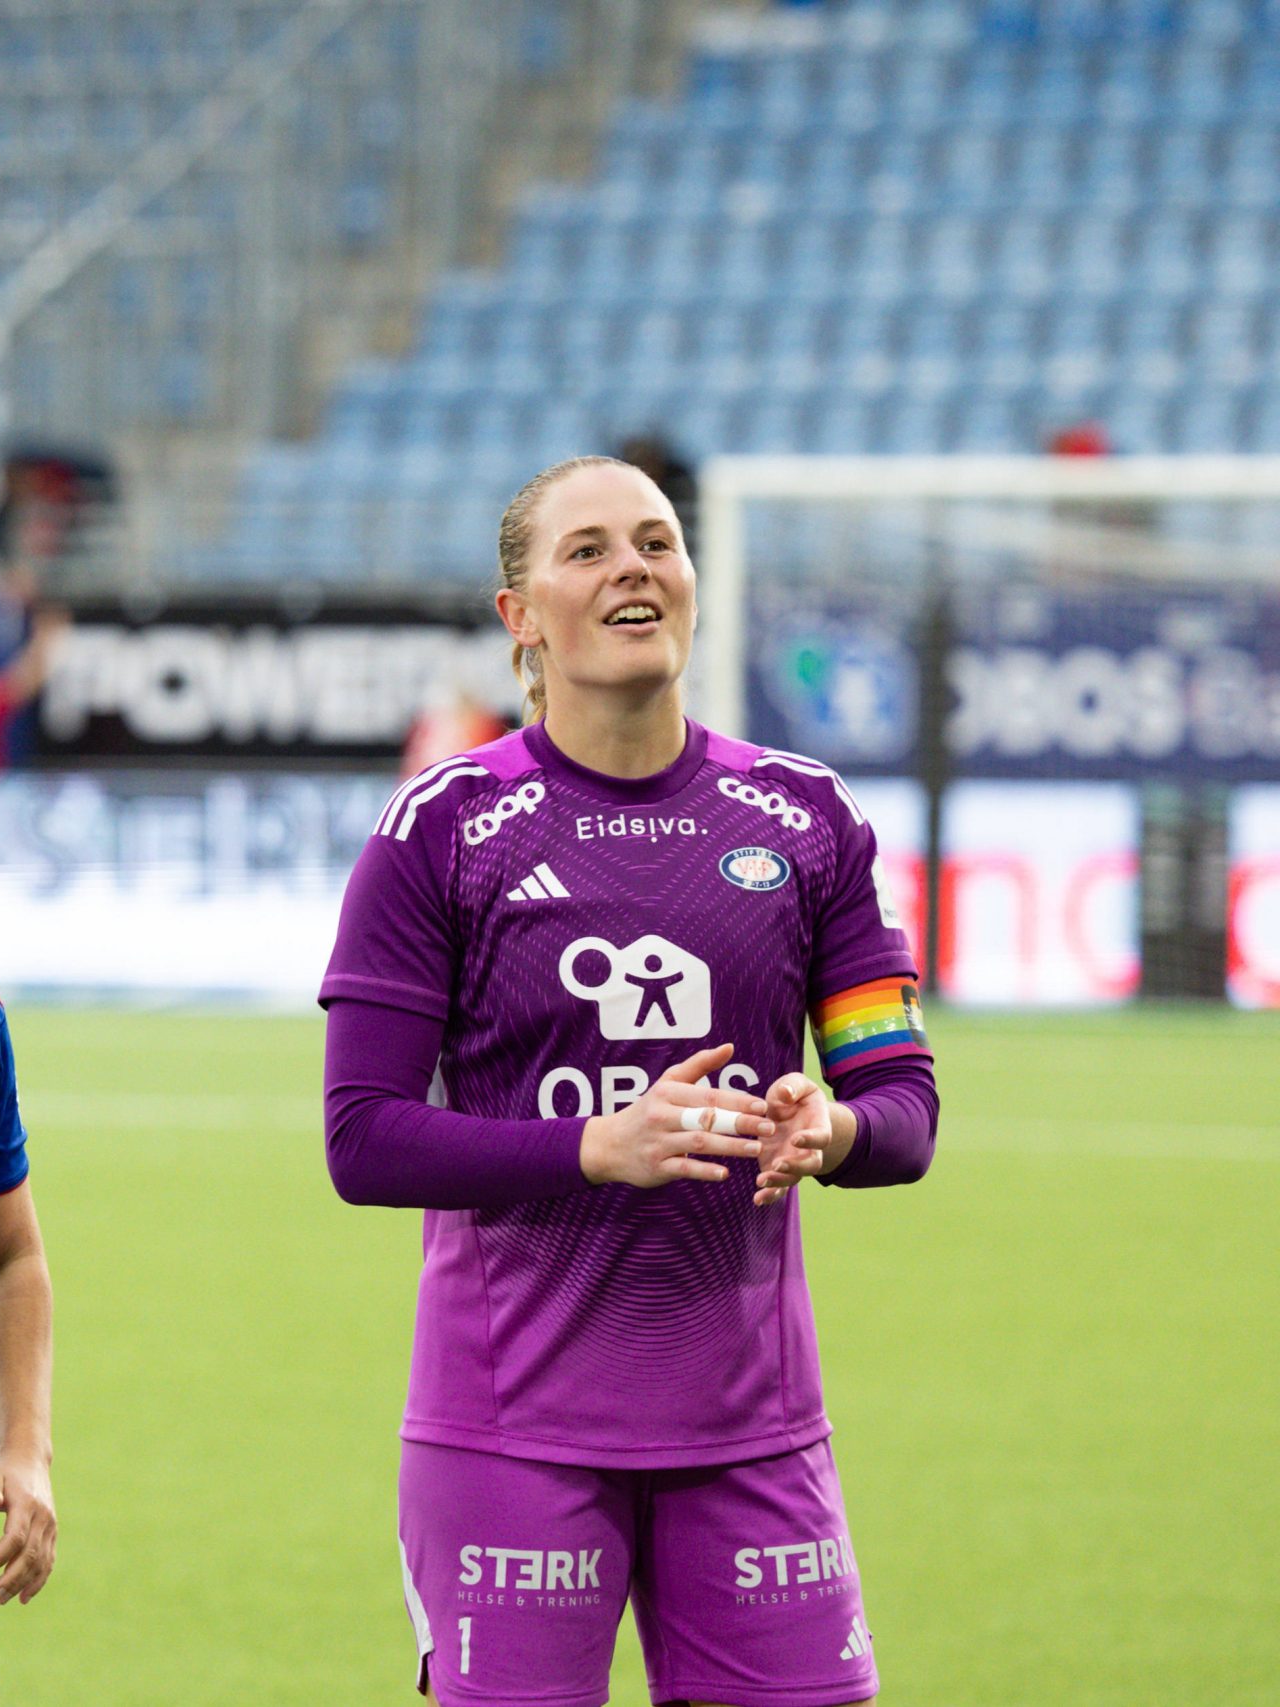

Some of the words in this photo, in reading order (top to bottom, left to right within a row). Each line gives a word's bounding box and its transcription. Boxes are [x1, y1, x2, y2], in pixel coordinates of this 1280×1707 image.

[464, 781, 546, 846] coop
[717, 777, 812, 831] coop
[458, 1544, 603, 1590] STERK
[458, 1591, 505, 1605] HELSE
[516, 1596, 525, 1606] &
[536, 1594, 600, 1607] TRENING
[736, 1592, 790, 1605] HELSE
[800, 1591, 808, 1600] &
[458, 1617, 472, 1675] 1
